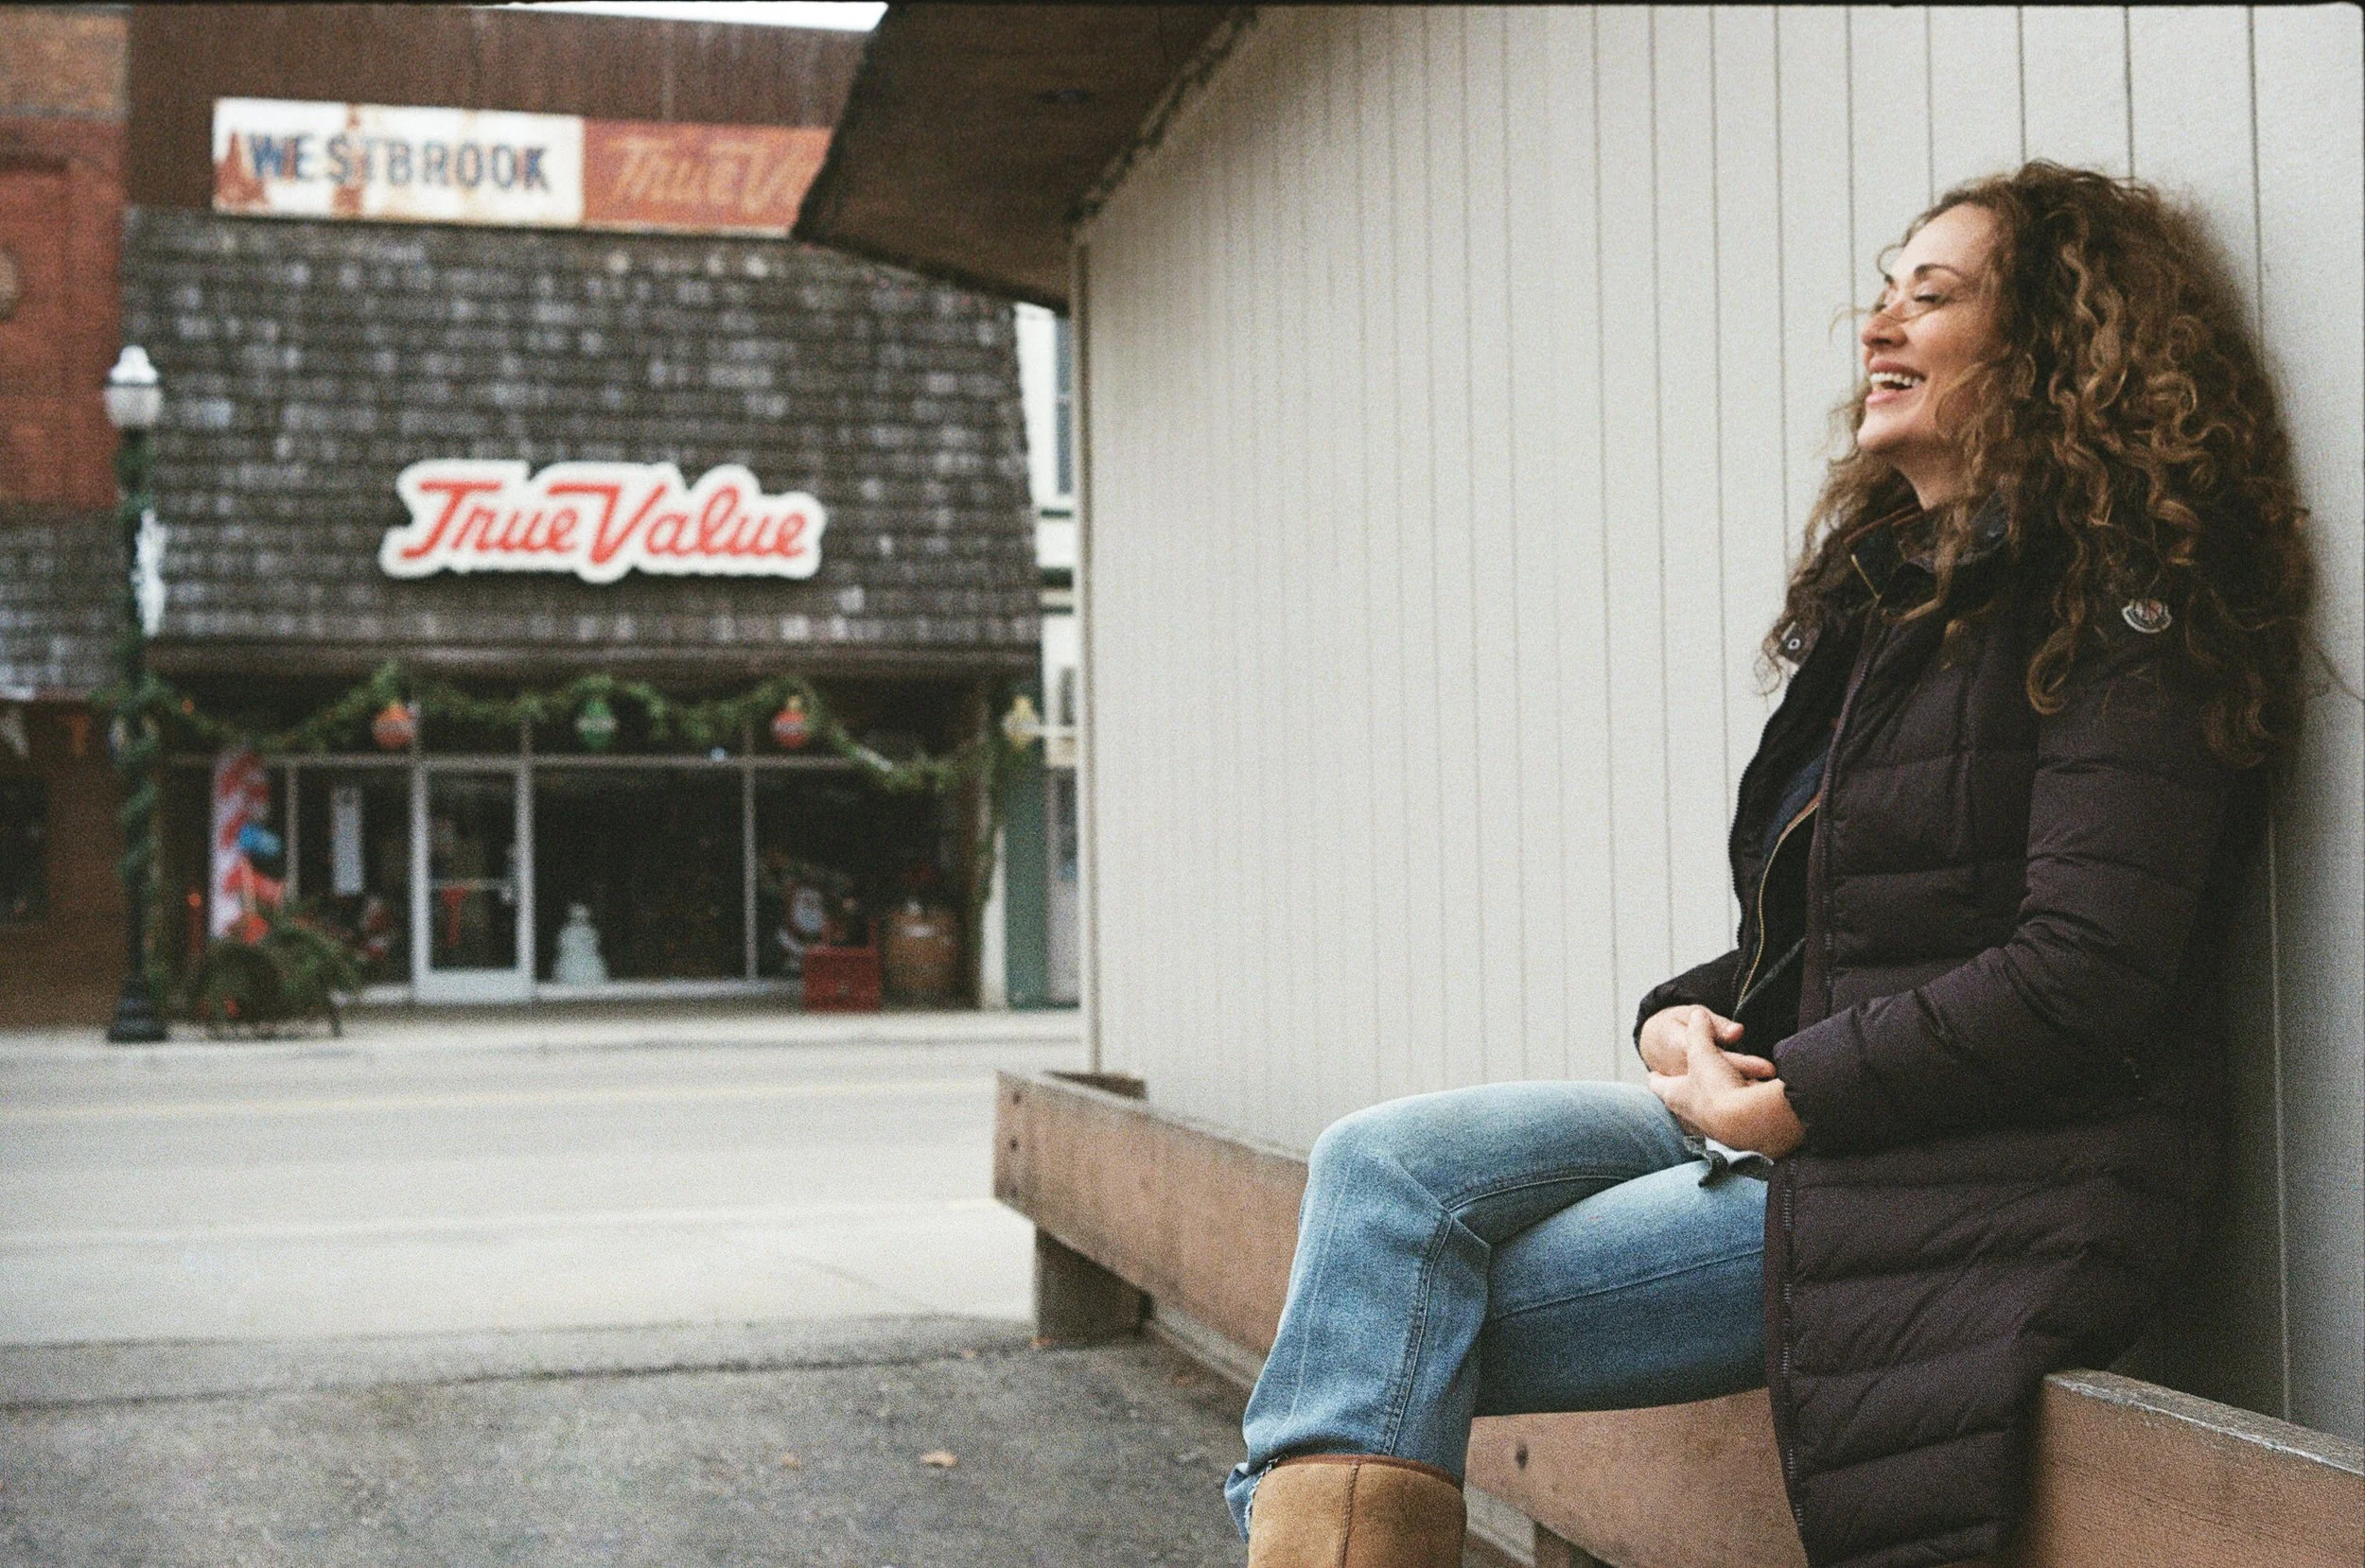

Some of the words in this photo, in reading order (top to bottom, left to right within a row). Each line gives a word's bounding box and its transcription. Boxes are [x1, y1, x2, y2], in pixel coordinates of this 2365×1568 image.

[247, 131, 552, 192] WESTBROOK
[401, 479, 579, 560] True
[547, 483, 809, 566] Value
